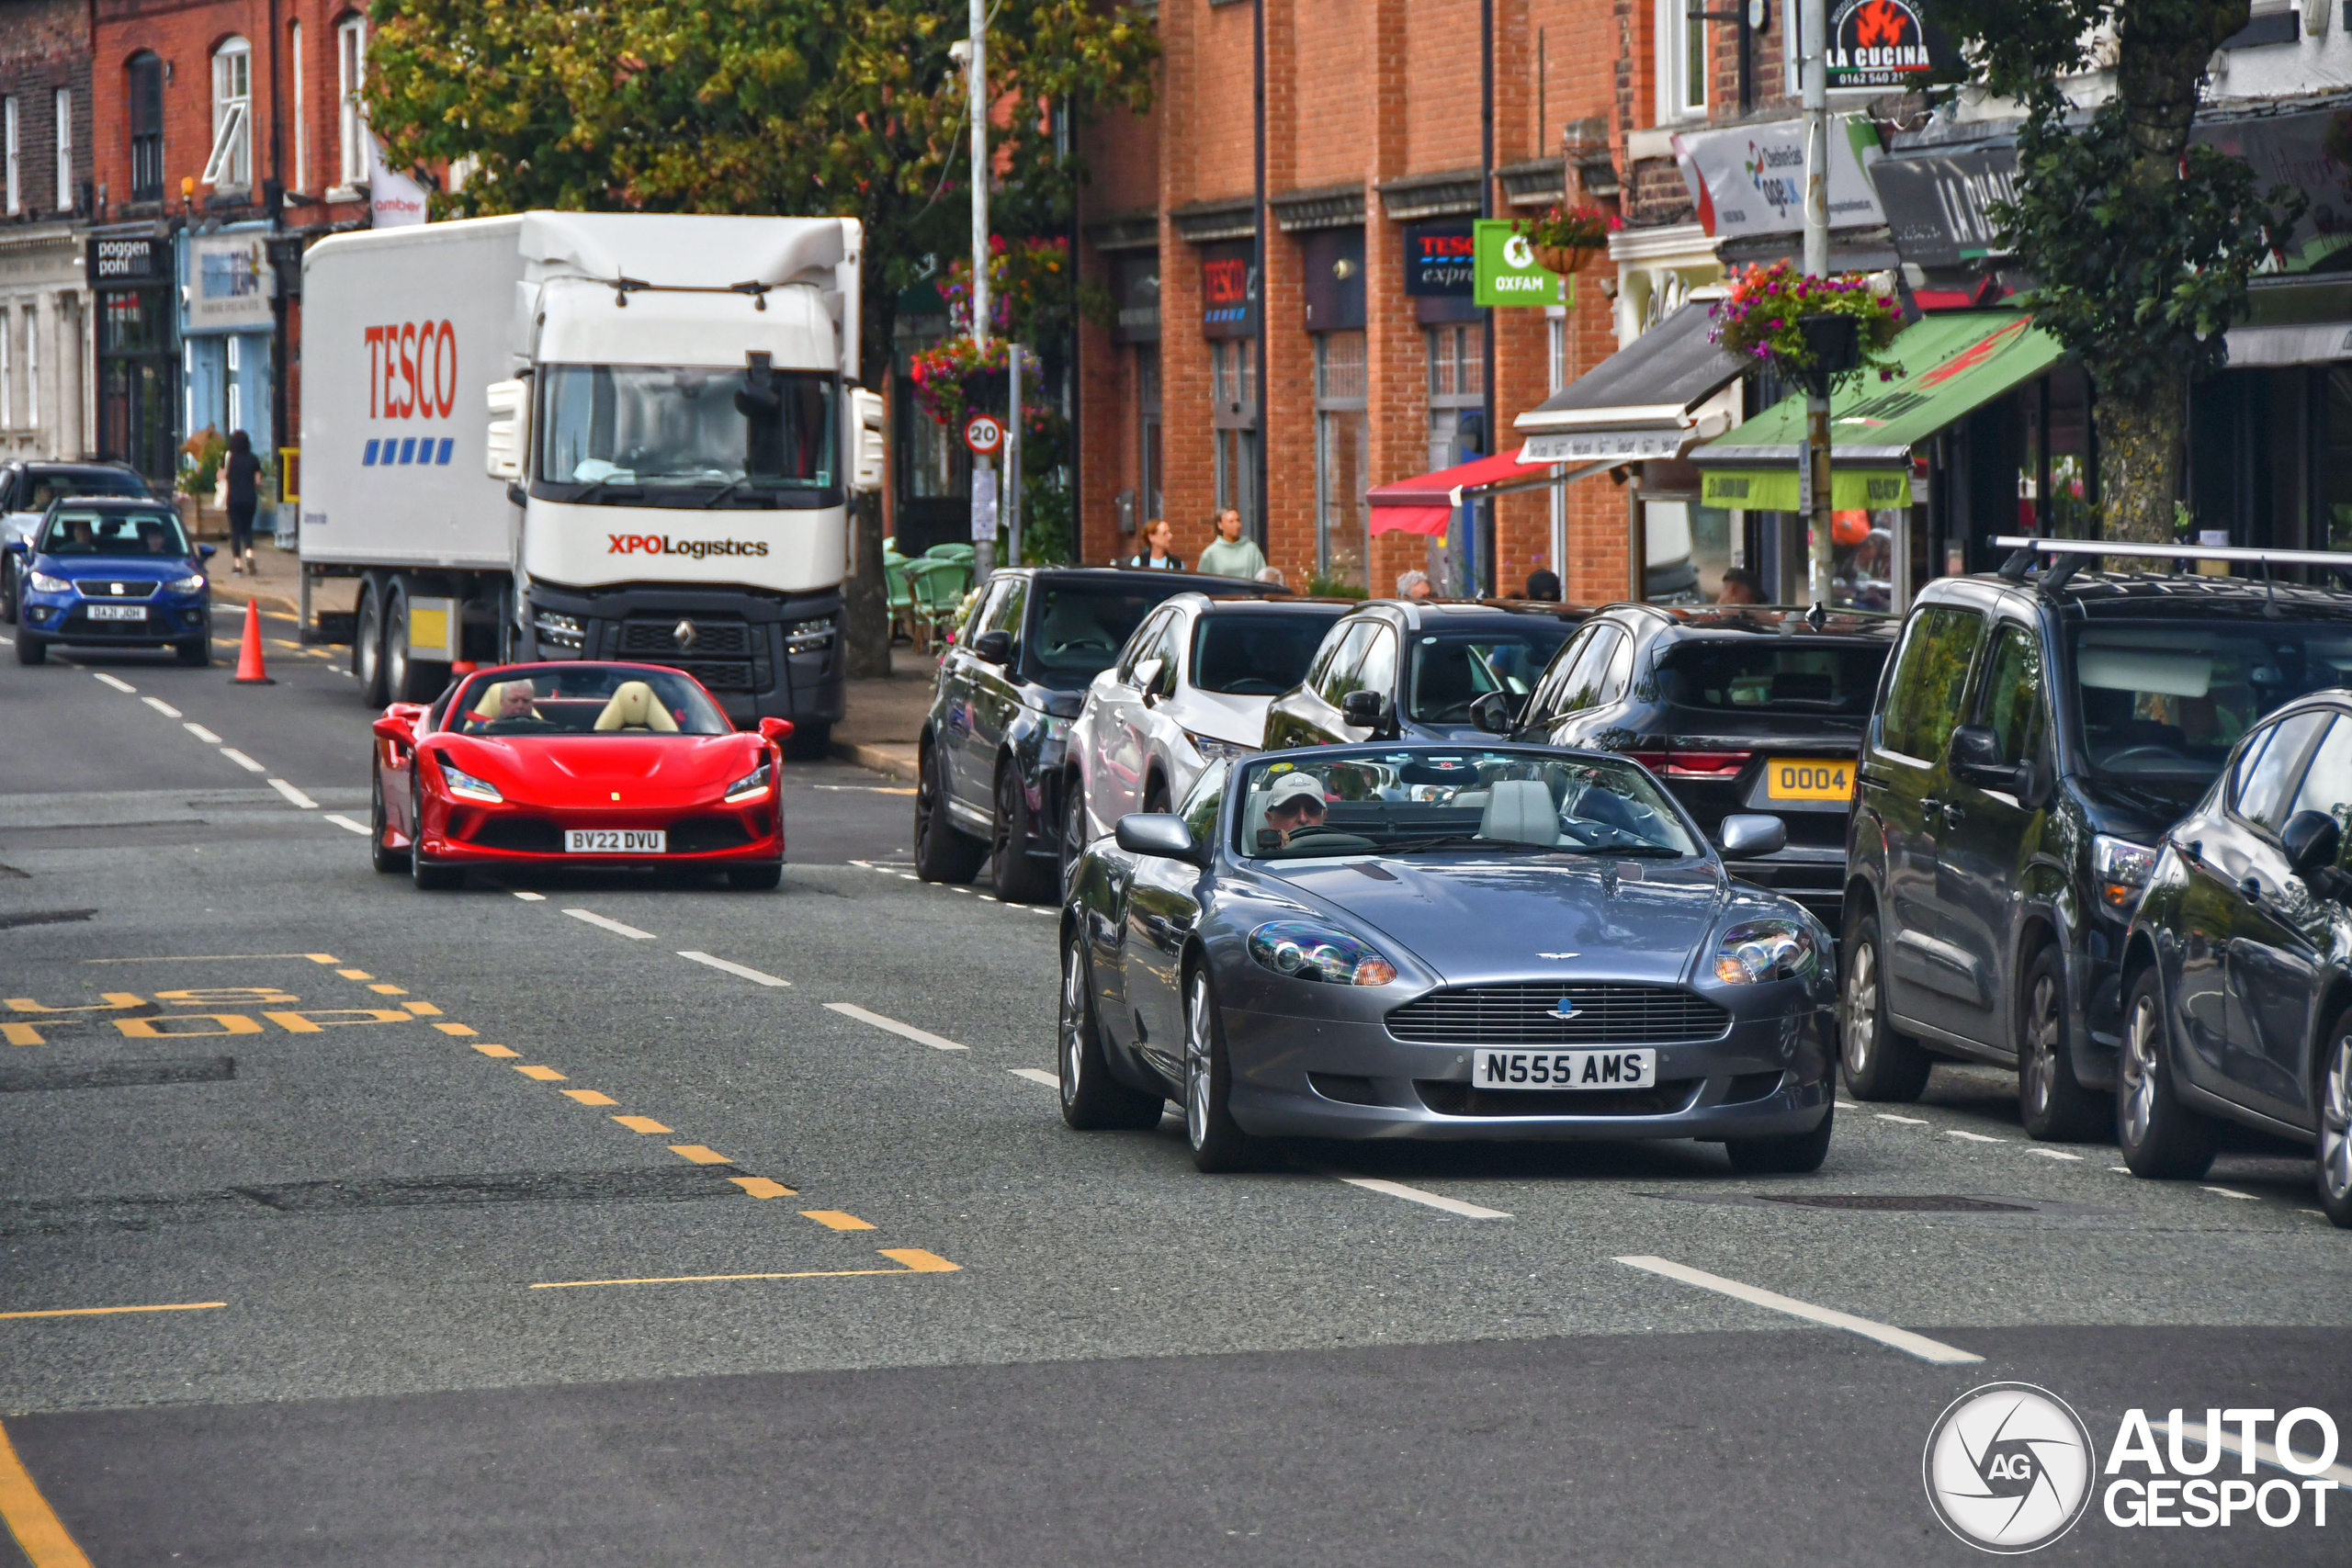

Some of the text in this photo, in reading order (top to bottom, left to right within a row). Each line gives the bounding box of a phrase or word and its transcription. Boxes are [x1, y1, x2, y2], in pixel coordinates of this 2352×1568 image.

[1826, 45, 1930, 68] LA CUCINA
[1838, 73, 1866, 85] 0162
[1869, 72, 1889, 84] 540
[374, 197, 421, 212] amber
[1934, 177, 1973, 243] LA
[98, 242, 150, 258] poggen
[98, 258, 130, 277] pohl
[1204, 258, 1246, 302] TESCO
[1496, 276, 1544, 291] OXFAM
[365, 319, 458, 419] TESCO
[970, 425, 997, 442] 20
[572, 832, 658, 849] BV22 DVU
[3, 987, 300, 1013] US
[0, 1009, 414, 1045] TOP
[1487, 1054, 1642, 1084] N555 AMS
